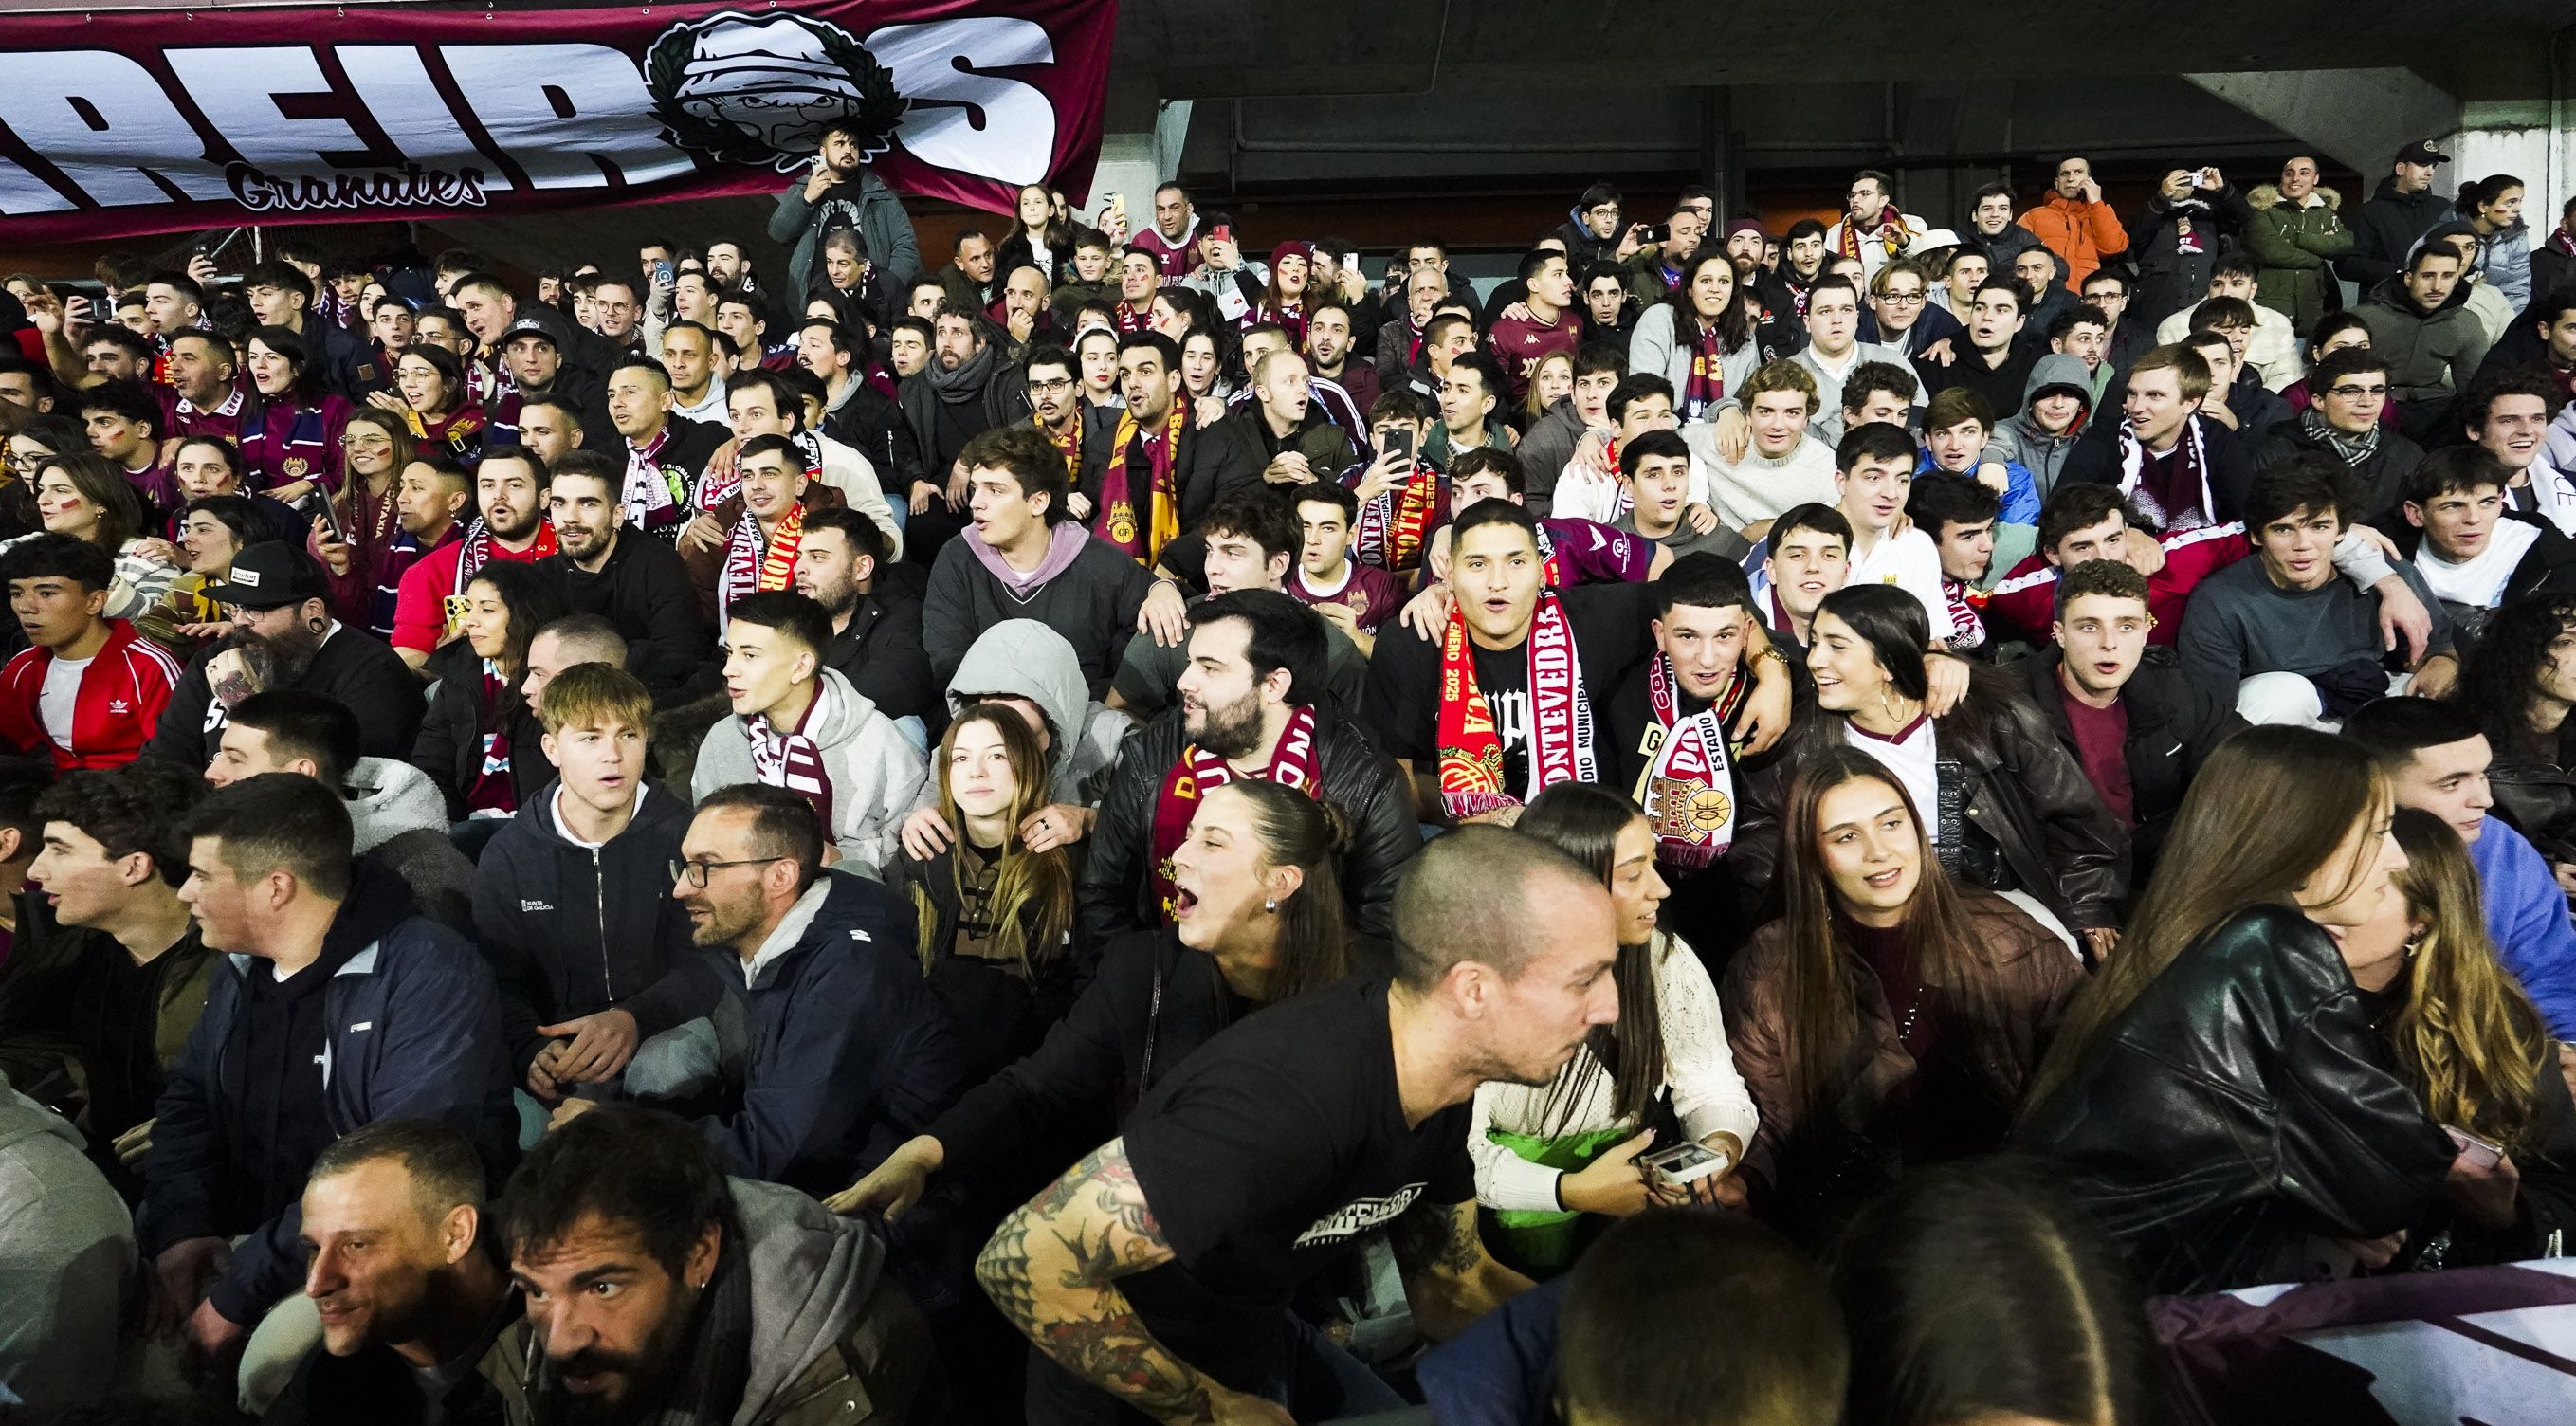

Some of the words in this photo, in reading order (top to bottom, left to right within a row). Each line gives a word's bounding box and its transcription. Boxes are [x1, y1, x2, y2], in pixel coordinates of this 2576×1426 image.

[224, 160, 488, 211] Granates
[1425, 474, 1436, 509] 2025
[1446, 622, 1462, 662] ENERO
[1445, 668, 1460, 702] 2025
[1532, 604, 1571, 787] ONTEVEDRA
[1699, 716, 1725, 772] ESTADIO
